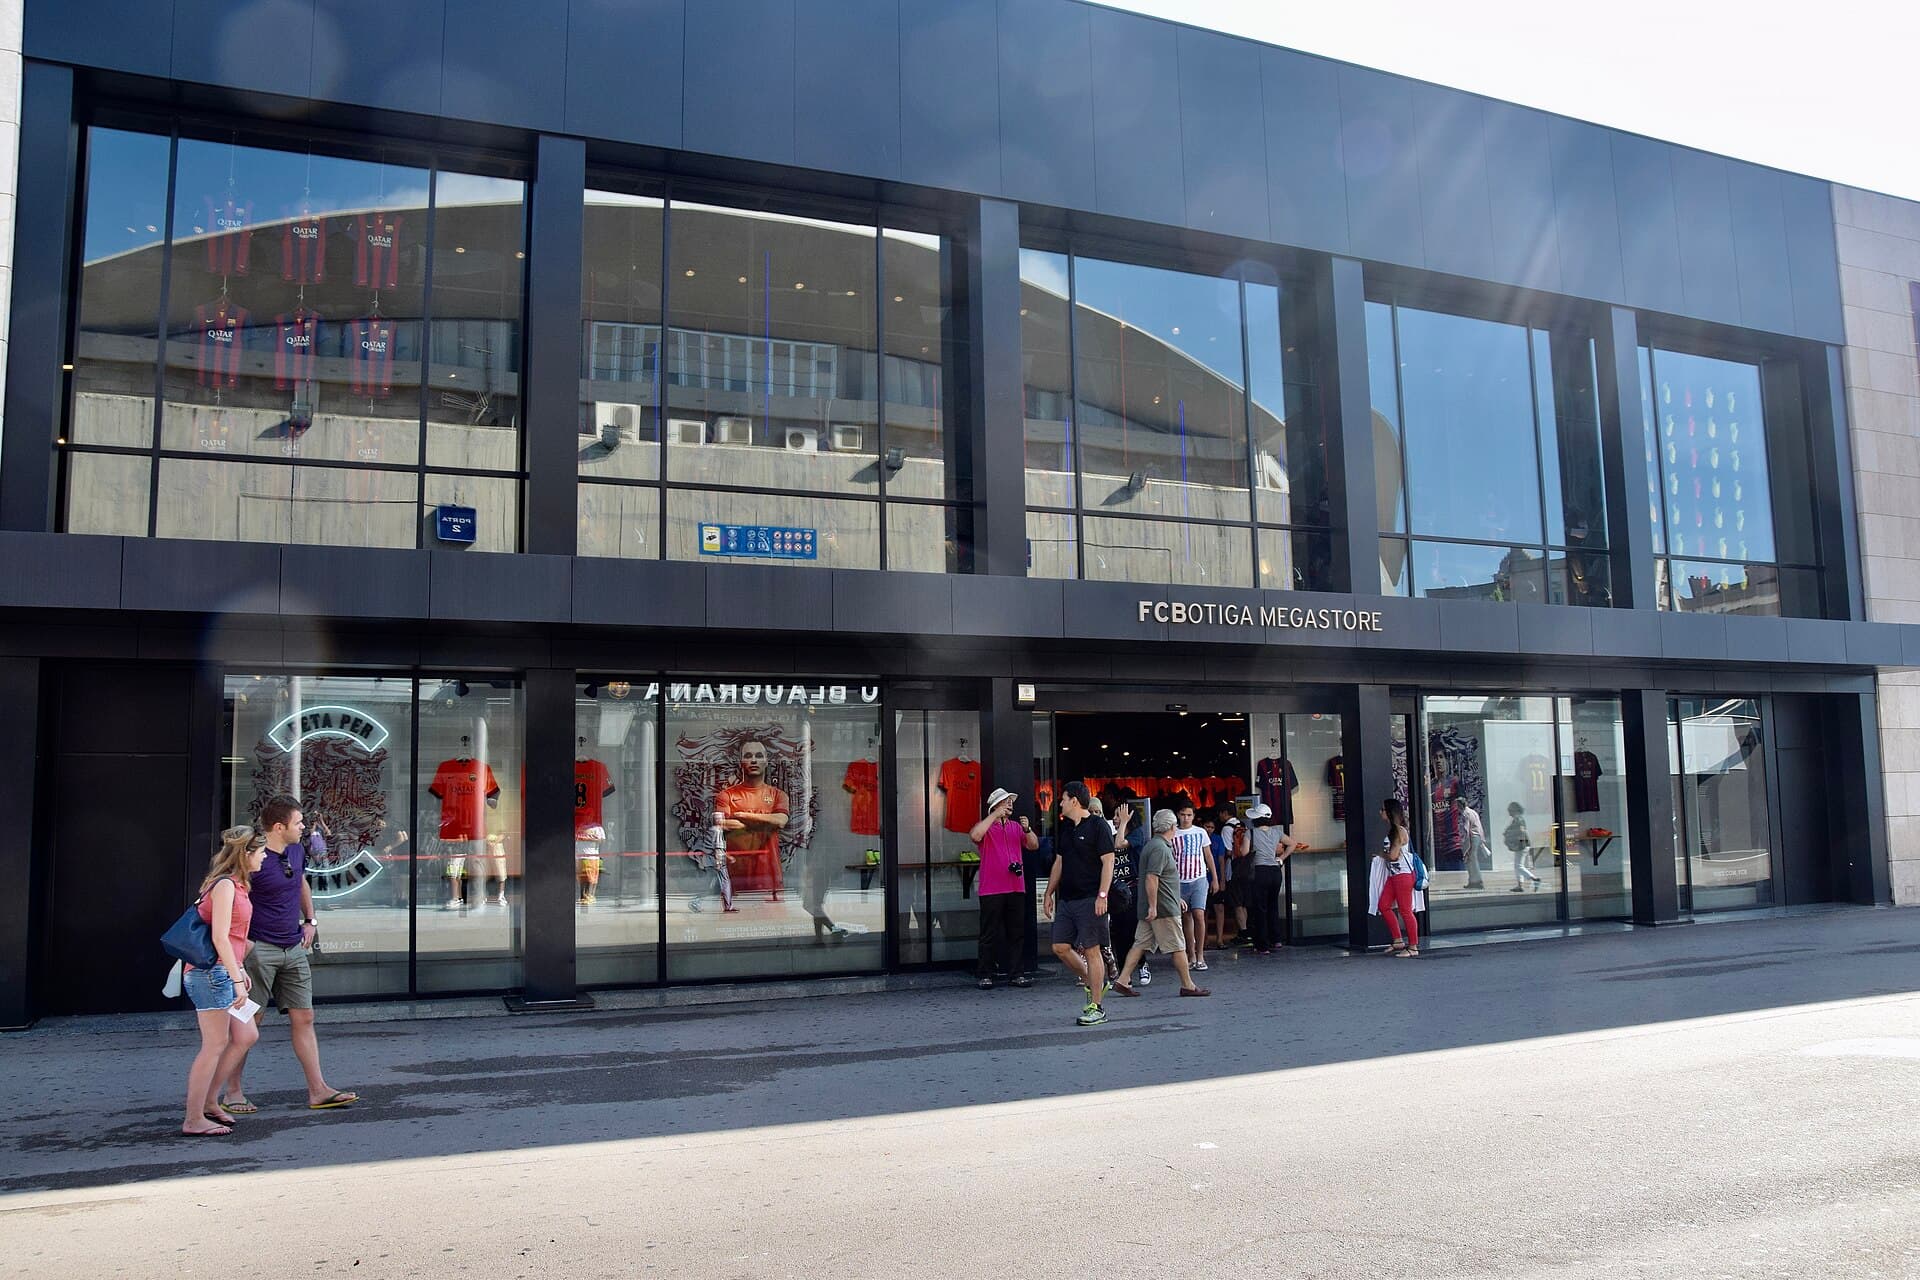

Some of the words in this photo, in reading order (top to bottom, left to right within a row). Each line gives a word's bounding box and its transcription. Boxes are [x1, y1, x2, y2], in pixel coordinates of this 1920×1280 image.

[217, 218, 242, 227] QATAR
[292, 226, 319, 235] QATAR
[367, 234, 392, 244] QATAR
[207, 329, 233, 339] QATAR
[286, 335, 311, 345] QATAR
[361, 340, 387, 350] QATAR
[1138, 600, 1254, 626] FCBOTIGA
[1260, 606, 1384, 632] MEGASTORE
[339, 713, 375, 739] PER
[575, 783, 587, 808] 8
